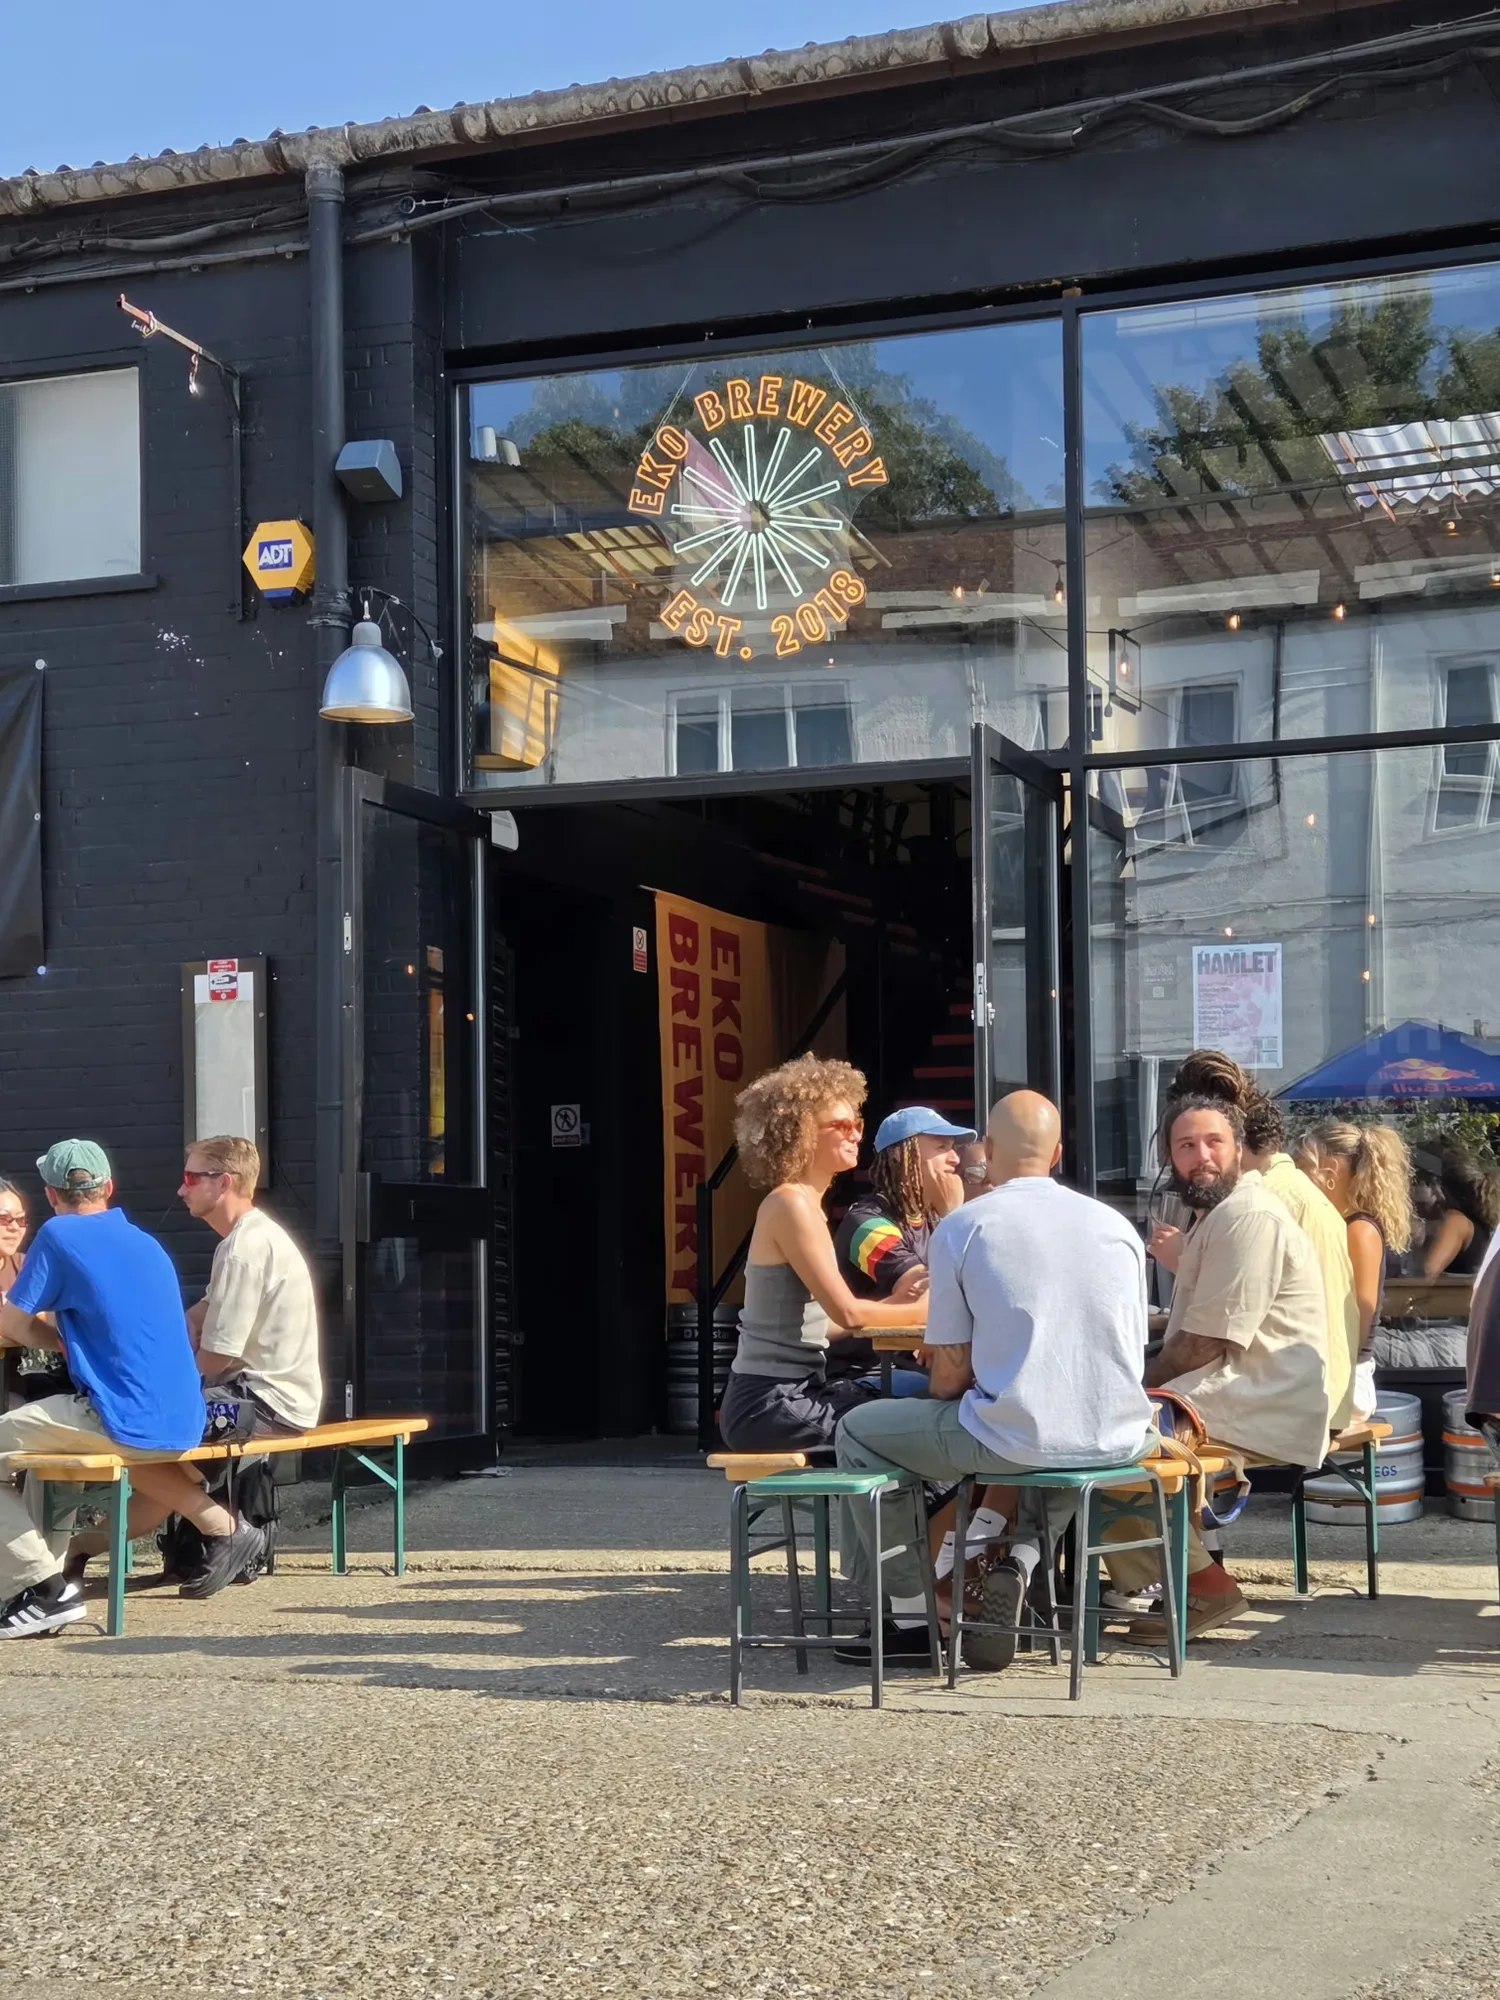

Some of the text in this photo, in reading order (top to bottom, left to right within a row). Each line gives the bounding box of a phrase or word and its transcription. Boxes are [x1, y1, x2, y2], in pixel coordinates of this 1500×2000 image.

[627, 375, 889, 515] EKO BREWERY
[259, 543, 292, 566] ADT
[660, 570, 866, 660] EST. 2018
[1197, 950, 1278, 975] HAMLET
[710, 926, 743, 1083] EKO
[1374, 1465, 1397, 1478] EGS
